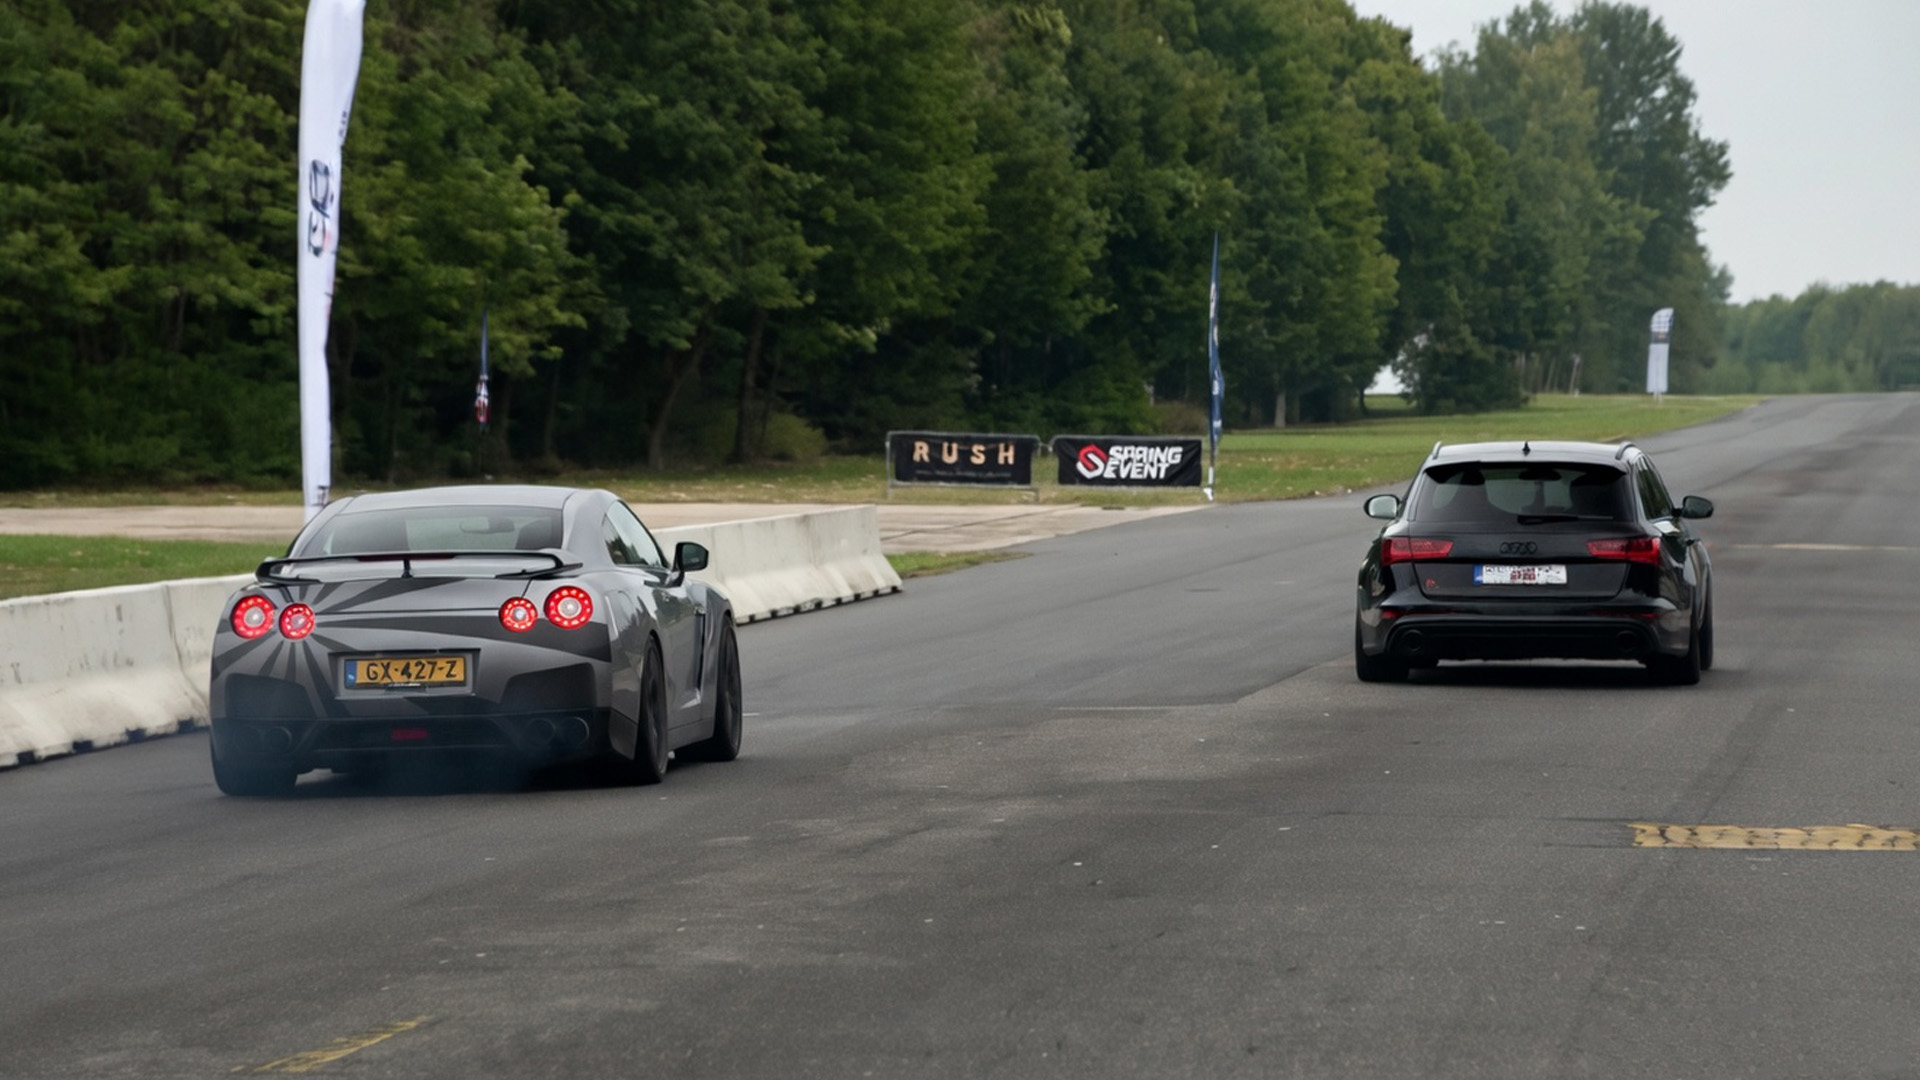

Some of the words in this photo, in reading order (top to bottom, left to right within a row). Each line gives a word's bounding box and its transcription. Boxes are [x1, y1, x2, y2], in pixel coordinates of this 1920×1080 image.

[913, 441, 1015, 465] RUSH
[1103, 459, 1170, 479] EVENT
[366, 660, 457, 681] GX-427-Z
